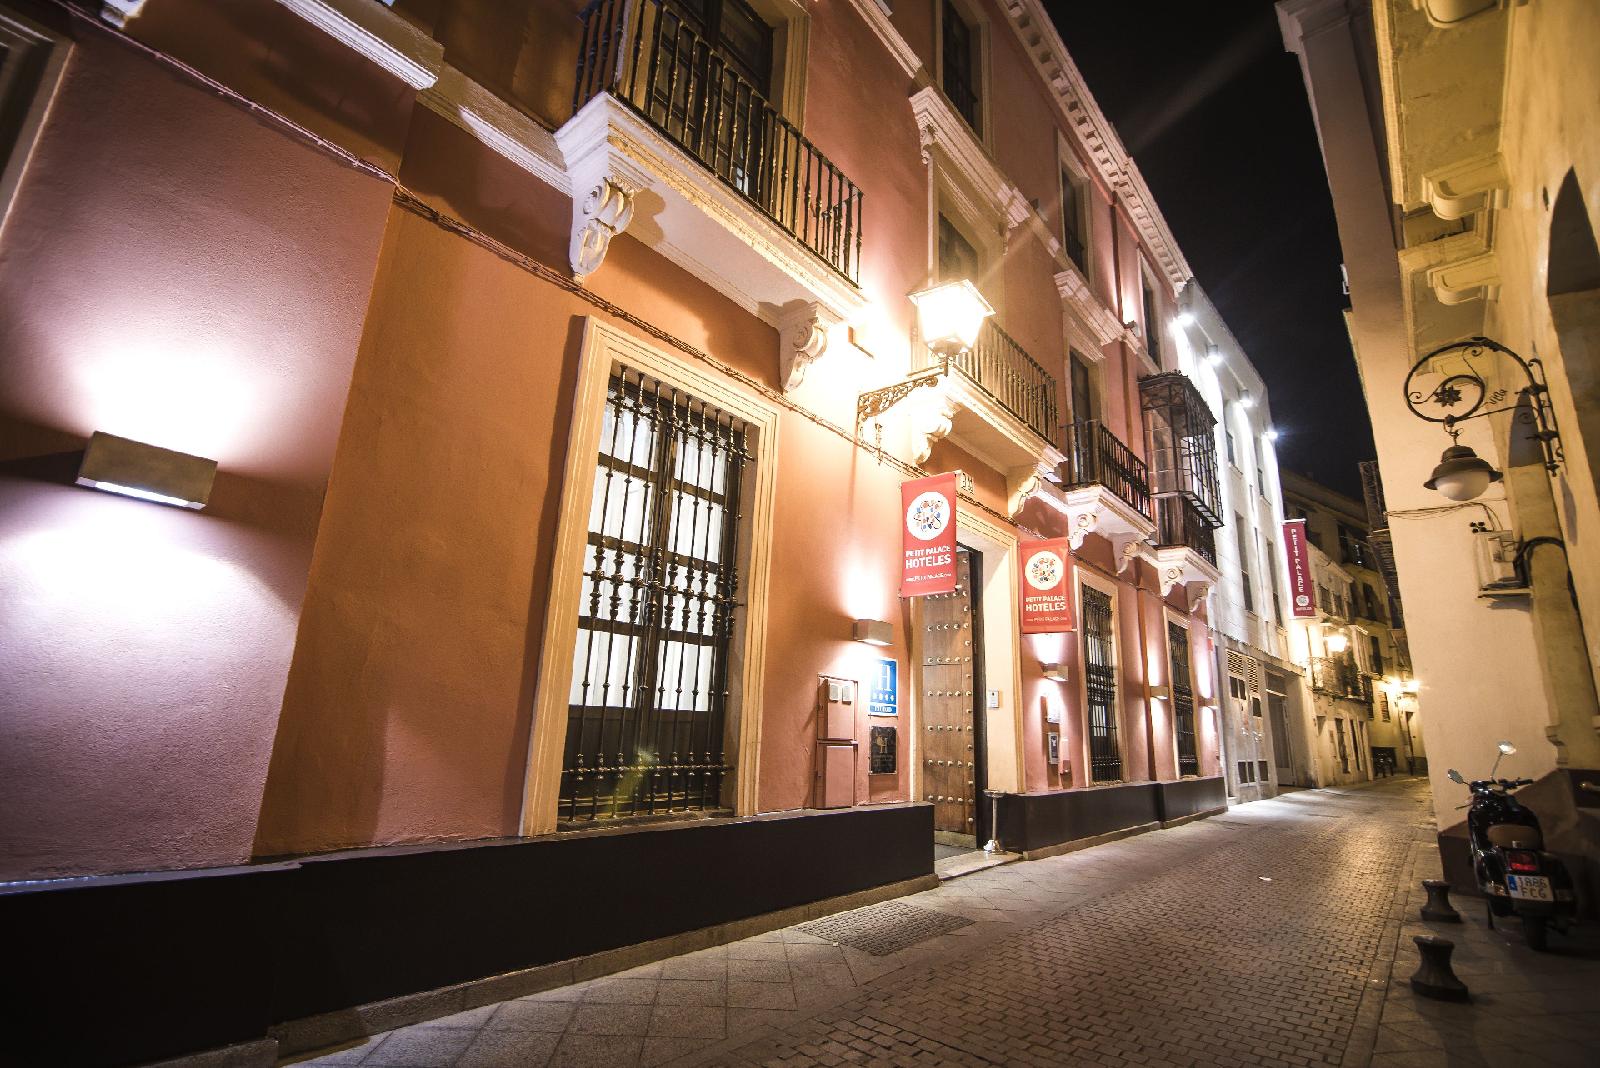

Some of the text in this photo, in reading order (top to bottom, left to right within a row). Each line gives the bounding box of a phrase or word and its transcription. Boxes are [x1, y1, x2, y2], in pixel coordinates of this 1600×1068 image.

[905, 545, 951, 557] PETIT PALACE
[905, 553, 952, 569] HOTELES
[1291, 528, 1304, 592] PETIT PALACE
[1025, 602, 1067, 612] HOTELES
